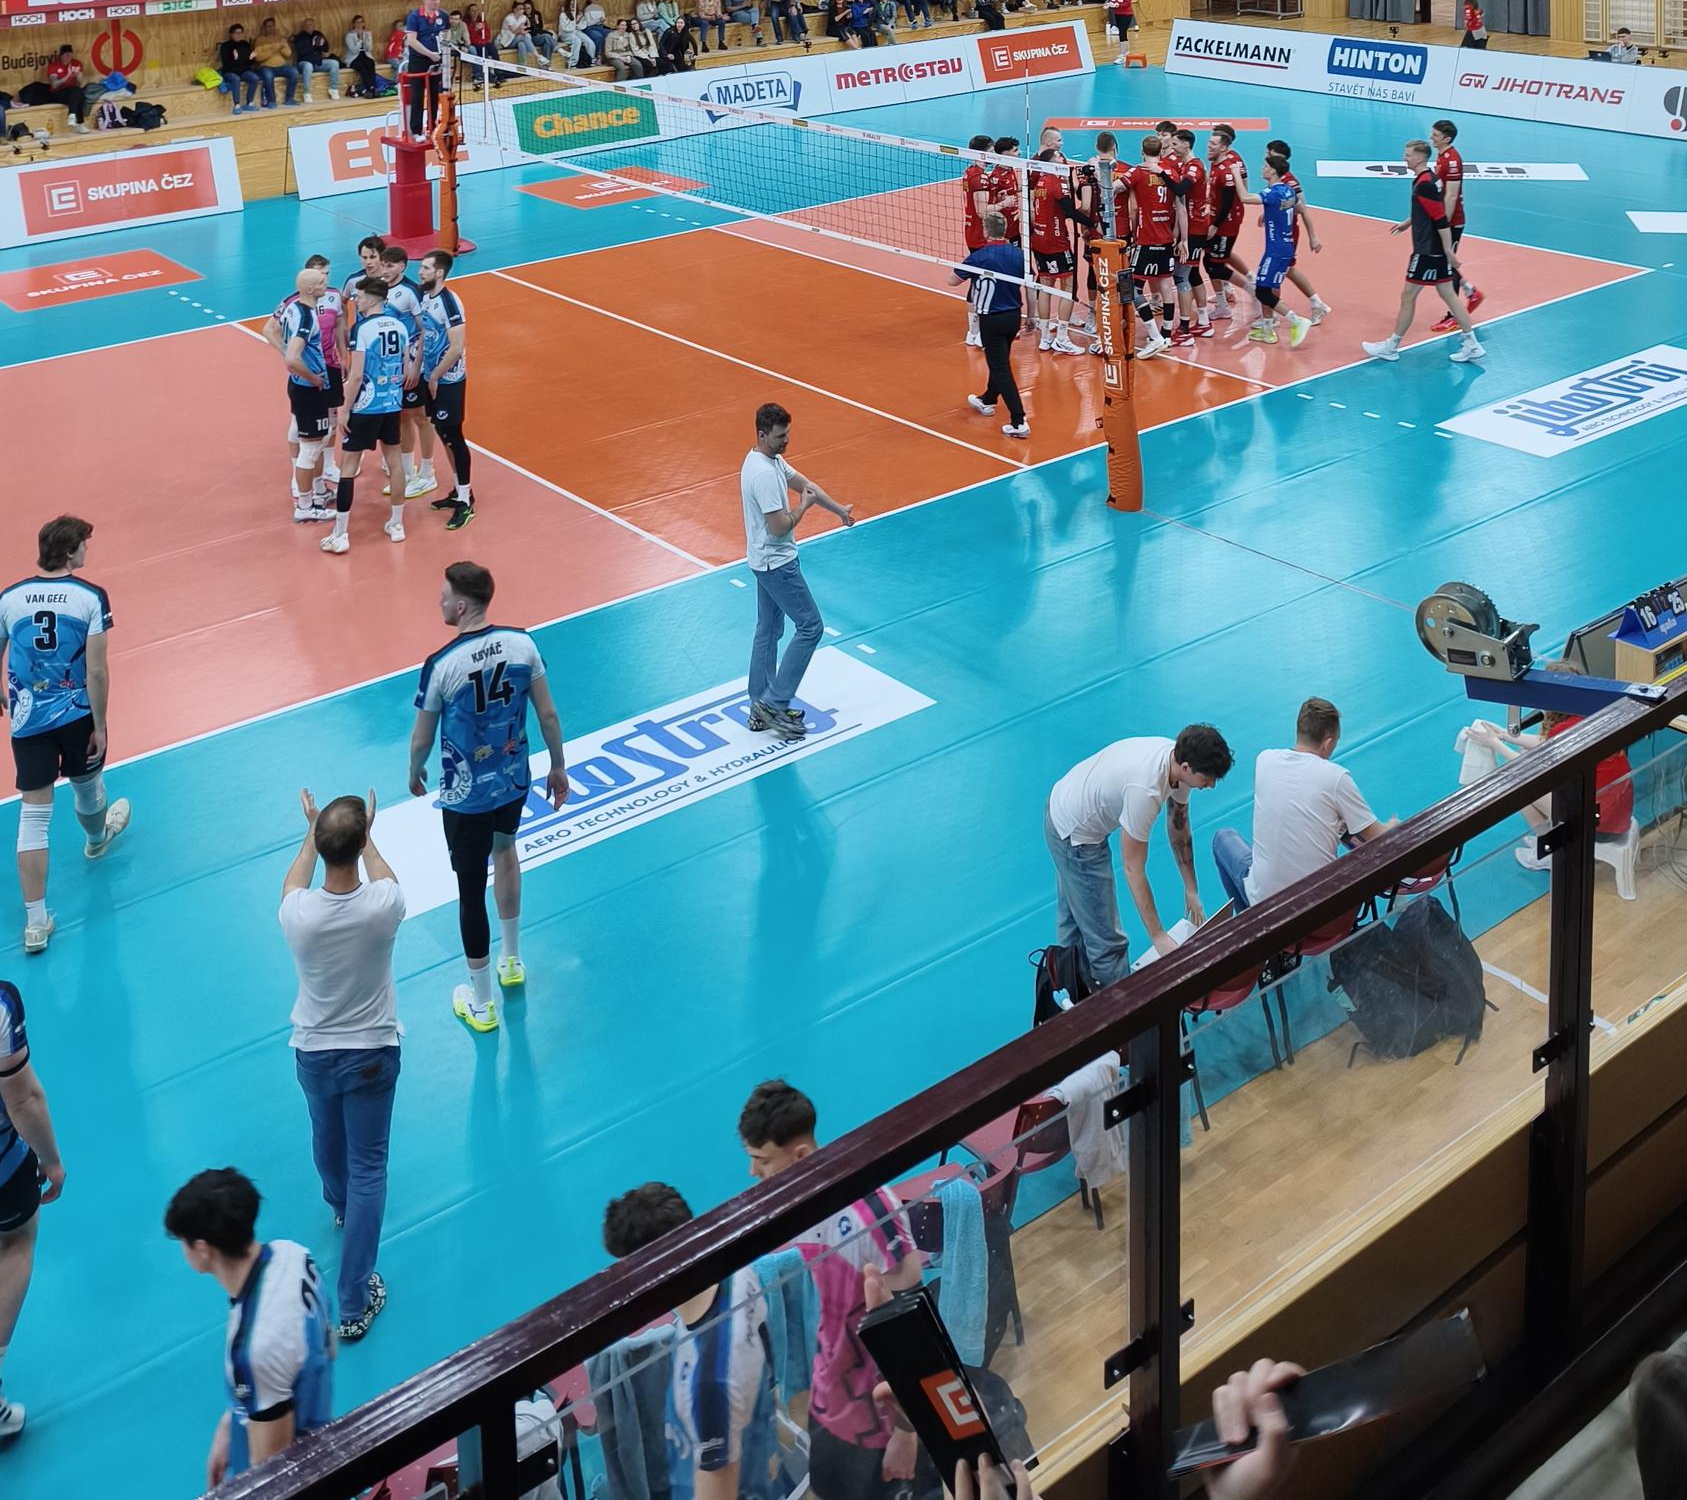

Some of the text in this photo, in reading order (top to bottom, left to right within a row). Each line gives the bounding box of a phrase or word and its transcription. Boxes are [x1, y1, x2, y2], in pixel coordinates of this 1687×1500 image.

[15, 14, 43, 25] HOCH
[58, 8, 95, 22] HOCH
[109, 5, 137, 16] HOCH
[2, 51, 62, 72] Budějovi
[1013, 46, 1050, 62] SKUPINA
[1051, 42, 1070, 56] ČEZ
[1175, 35, 1292, 64] FACKELMANN
[1333, 46, 1423, 76] HINTON
[715, 77, 788, 107] MADETA
[1328, 81, 1416, 103] STAVĚT NÁS BAVÍ
[1491, 76, 1625, 106] JIHOTRANS
[533, 107, 641, 139] Chance
[88, 179, 159, 201] SKUPINA
[161, 173, 194, 190] ČEZ
[1157, 185, 1168, 204] 91
[26, 277, 123, 298] SKUPINA
[1099, 290, 1114, 355] SKUPINA
[378, 330, 400, 358] 19
[316, 419, 330, 432] 10
[25, 593, 68, 604] VAN GEEL
[1640, 605, 1657, 629] 16
[1667, 591, 1686, 615] 25
[32, 610, 59, 652] 3
[468, 660, 517, 715] 14
[523, 735, 807, 853] AERO TECHNOLOGY & HYDRAULICS
